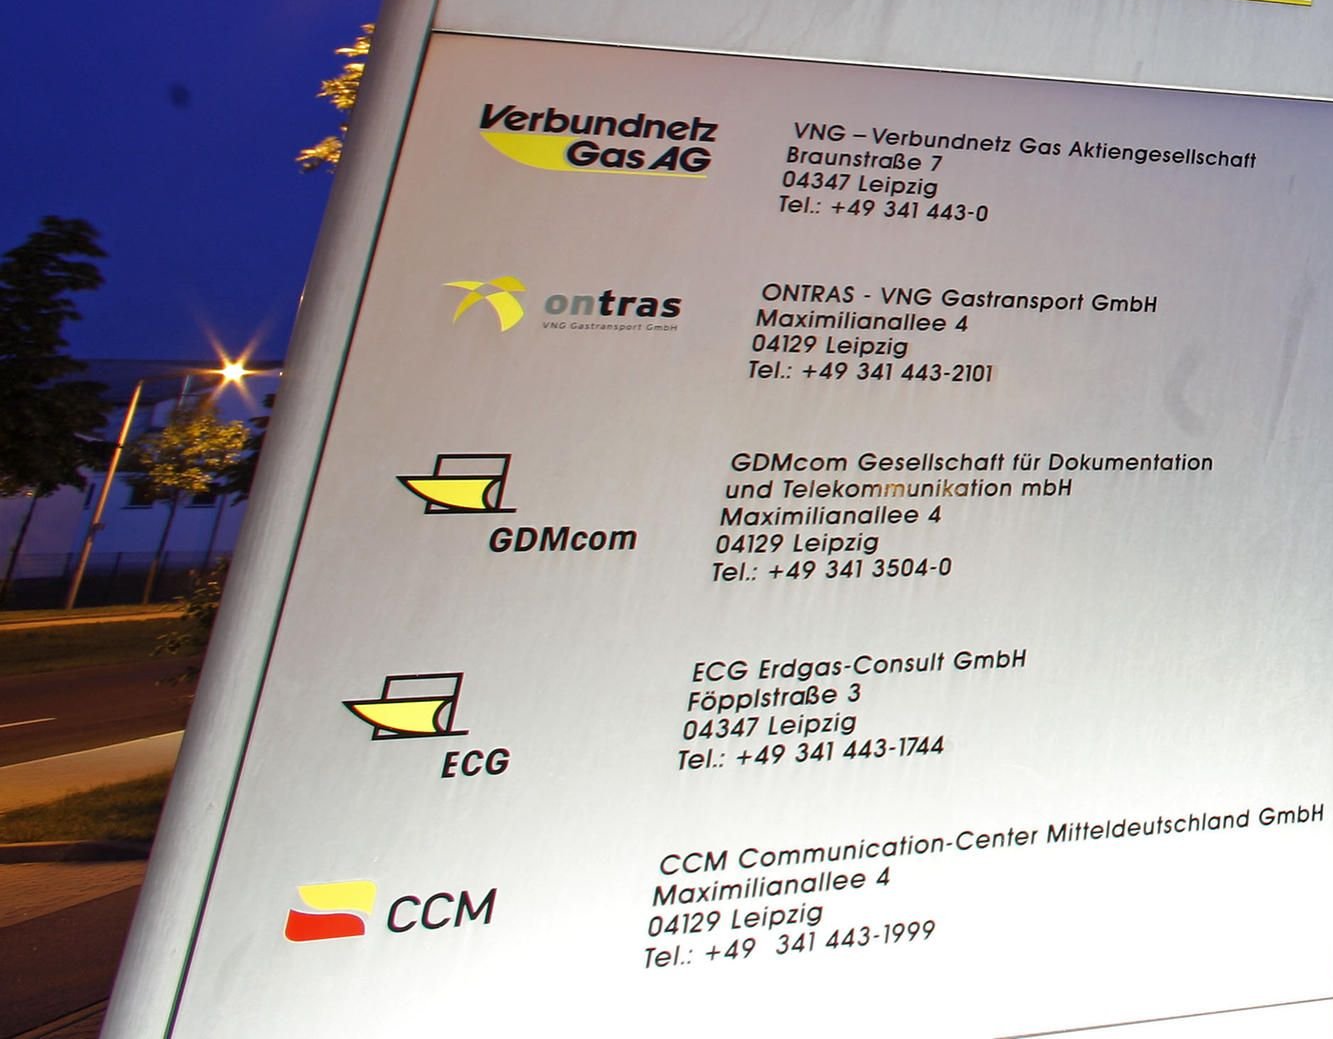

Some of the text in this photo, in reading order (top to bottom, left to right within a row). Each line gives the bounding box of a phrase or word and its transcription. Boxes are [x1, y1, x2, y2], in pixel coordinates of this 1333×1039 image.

[479, 103, 719, 143] Verbundnetz
[566, 140, 712, 173] Gas AG
[786, 146, 943, 172] Braunstraße 7
[794, 122, 846, 142] VNG
[872, 127, 1012, 153] Verbundnetz
[1019, 137, 1062, 156] Gas
[1068, 141, 1257, 169] Aktiengesellschaft
[782, 170, 938, 199] 04347 Leipzig
[779, 194, 989, 222] Tel.: +49 341 443-0
[544, 290, 682, 317] ontras
[761, 283, 855, 304] ONTRAS
[881, 287, 932, 306] VNG
[941, 289, 1084, 313] Gastransport
[1091, 294, 1157, 313] GmbH
[756, 308, 968, 332] Maximilianallee 4
[752, 333, 909, 360] 04129 Leipzig
[749, 360, 993, 383] Tel.: +49 341 443-2101
[731, 452, 1213, 472] GDMcom Gesellschaft für Dokumentation
[725, 478, 1073, 499] und Telekommunikation mbH
[719, 505, 941, 526] Maximilianallee 4
[488, 526, 637, 553] GDMcom
[715, 532, 879, 556] 04129 Leipzig
[712, 557, 952, 582] Tel.: +49 341 3504-0
[692, 648, 1027, 683] ECG Erdgas-Consult GmbH
[687, 682, 861, 715] Föpplstraße 3
[683, 712, 857, 741] 04347 Leipzig
[440, 748, 510, 779] ECG
[678, 735, 944, 771] Tel.: +49 341 443-1744
[659, 803, 1324, 876] CCM Communication-Center Mitteldeutschland GmbH
[652, 866, 890, 907] Maximilianallee 4
[386, 887, 497, 933] CCM
[648, 902, 823, 938] 04129 Leipzig
[645, 919, 936, 969] Tel.: +49 341 443-1999
